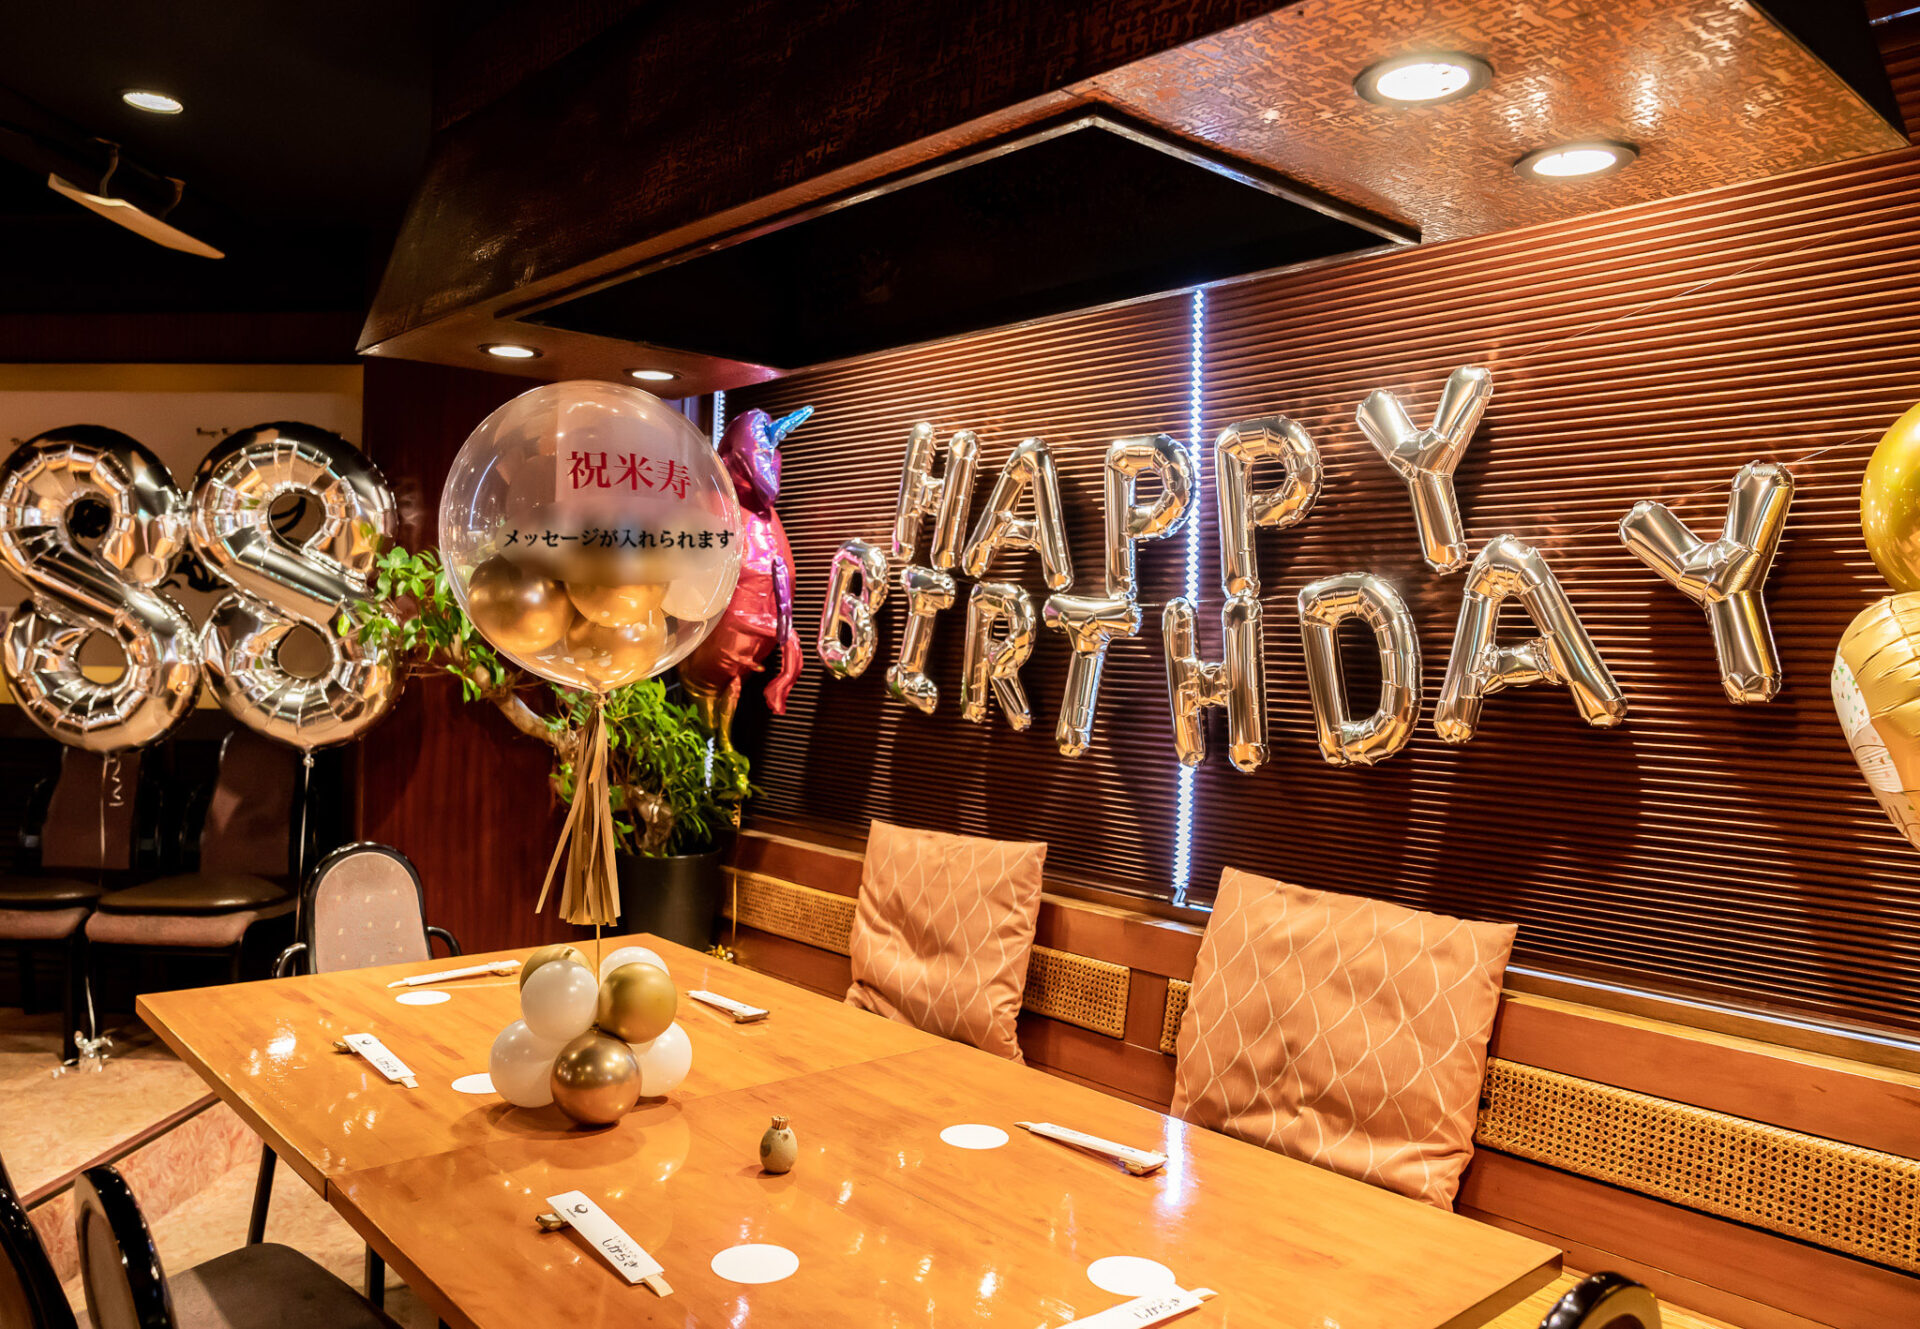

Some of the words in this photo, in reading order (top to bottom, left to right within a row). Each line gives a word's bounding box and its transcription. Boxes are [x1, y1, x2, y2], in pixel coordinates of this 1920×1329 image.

[0, 421, 402, 754] 88
[566, 450, 692, 500] 祝米寿
[892, 365, 1494, 601] HAPPY
[817, 461, 1795, 773] BIRTHDAY
